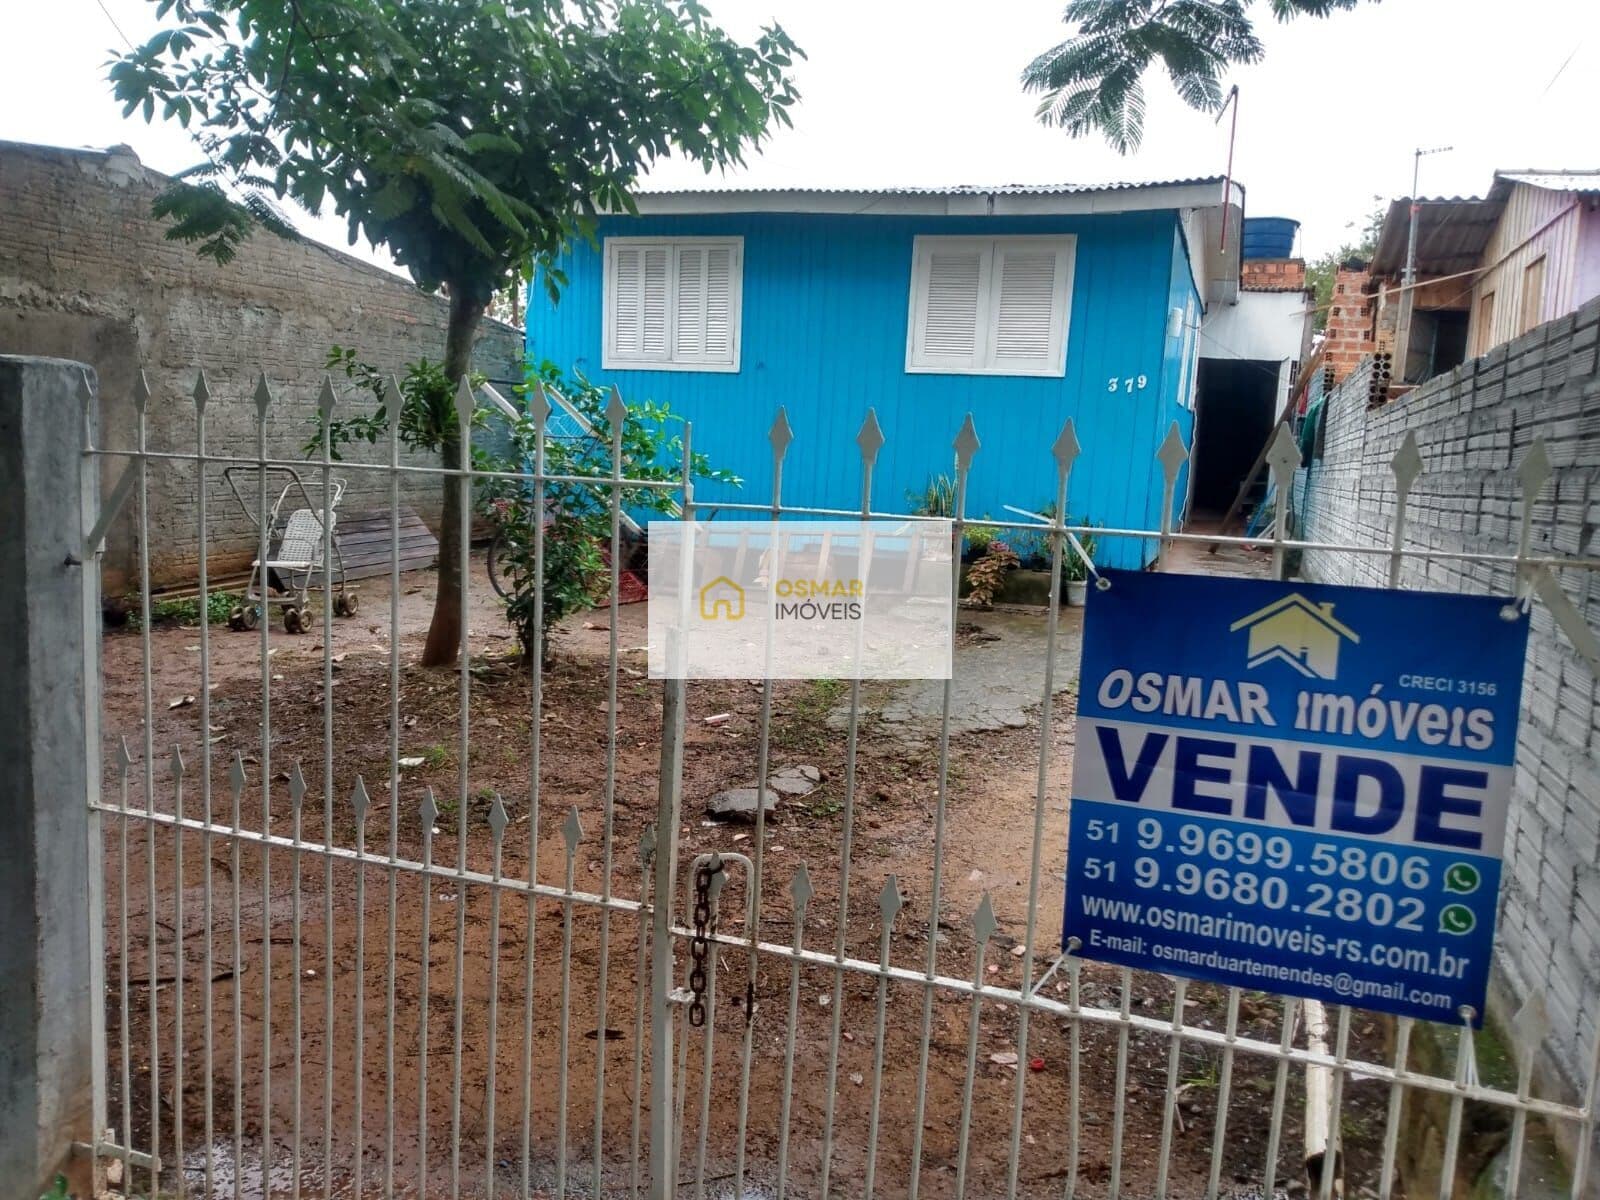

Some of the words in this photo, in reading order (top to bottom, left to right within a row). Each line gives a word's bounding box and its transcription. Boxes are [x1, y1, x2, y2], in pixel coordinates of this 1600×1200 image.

[1108, 375, 1147, 393] 379
[1097, 668, 1277, 728] OSMAR
[1399, 674, 1453, 692] CRECI
[1457, 679, 1497, 697] 3156
[1095, 725, 1488, 851] VENDE
[1086, 819, 1120, 844] 51
[1136, 817, 1431, 891] 9.9699.5806
[1083, 857, 1117, 883] 51
[1133, 856, 1426, 932] 9.9680.2802
[1081, 894, 1470, 980] www.osmarimoveis-rs.com.br
[1090, 929, 1147, 956] E-mail:
[1151, 940, 1452, 1010] osmarduartemendes@gmail.com
